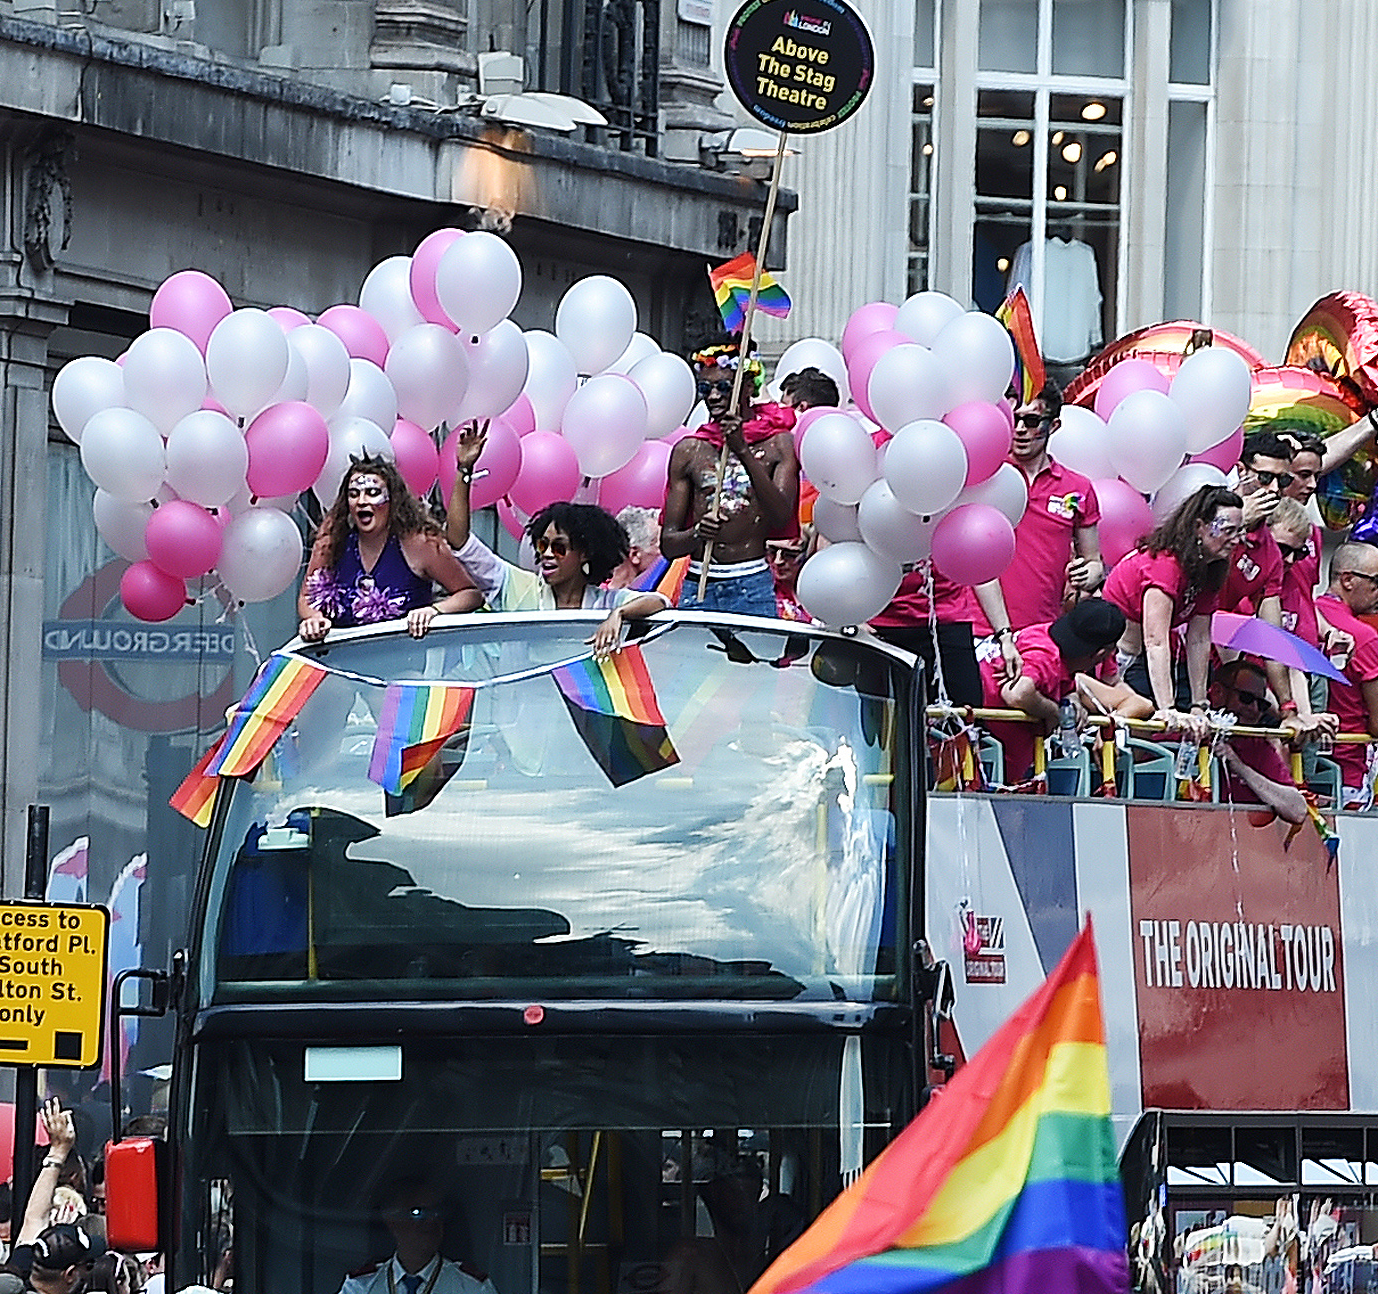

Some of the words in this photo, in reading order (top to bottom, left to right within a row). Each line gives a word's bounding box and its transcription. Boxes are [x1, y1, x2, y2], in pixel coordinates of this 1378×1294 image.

[771, 36, 829, 64] Above
[758, 53, 791, 78] The
[793, 65, 836, 93] Stag
[756, 76, 827, 110] Theatre
[57, 910, 81, 930] to
[68, 935, 96, 955] Pl.
[1139, 919, 1184, 988] THE
[1186, 919, 1282, 990] ORIGINAL
[1280, 924, 1336, 992] TOUR
[51, 982, 82, 1002] St.
